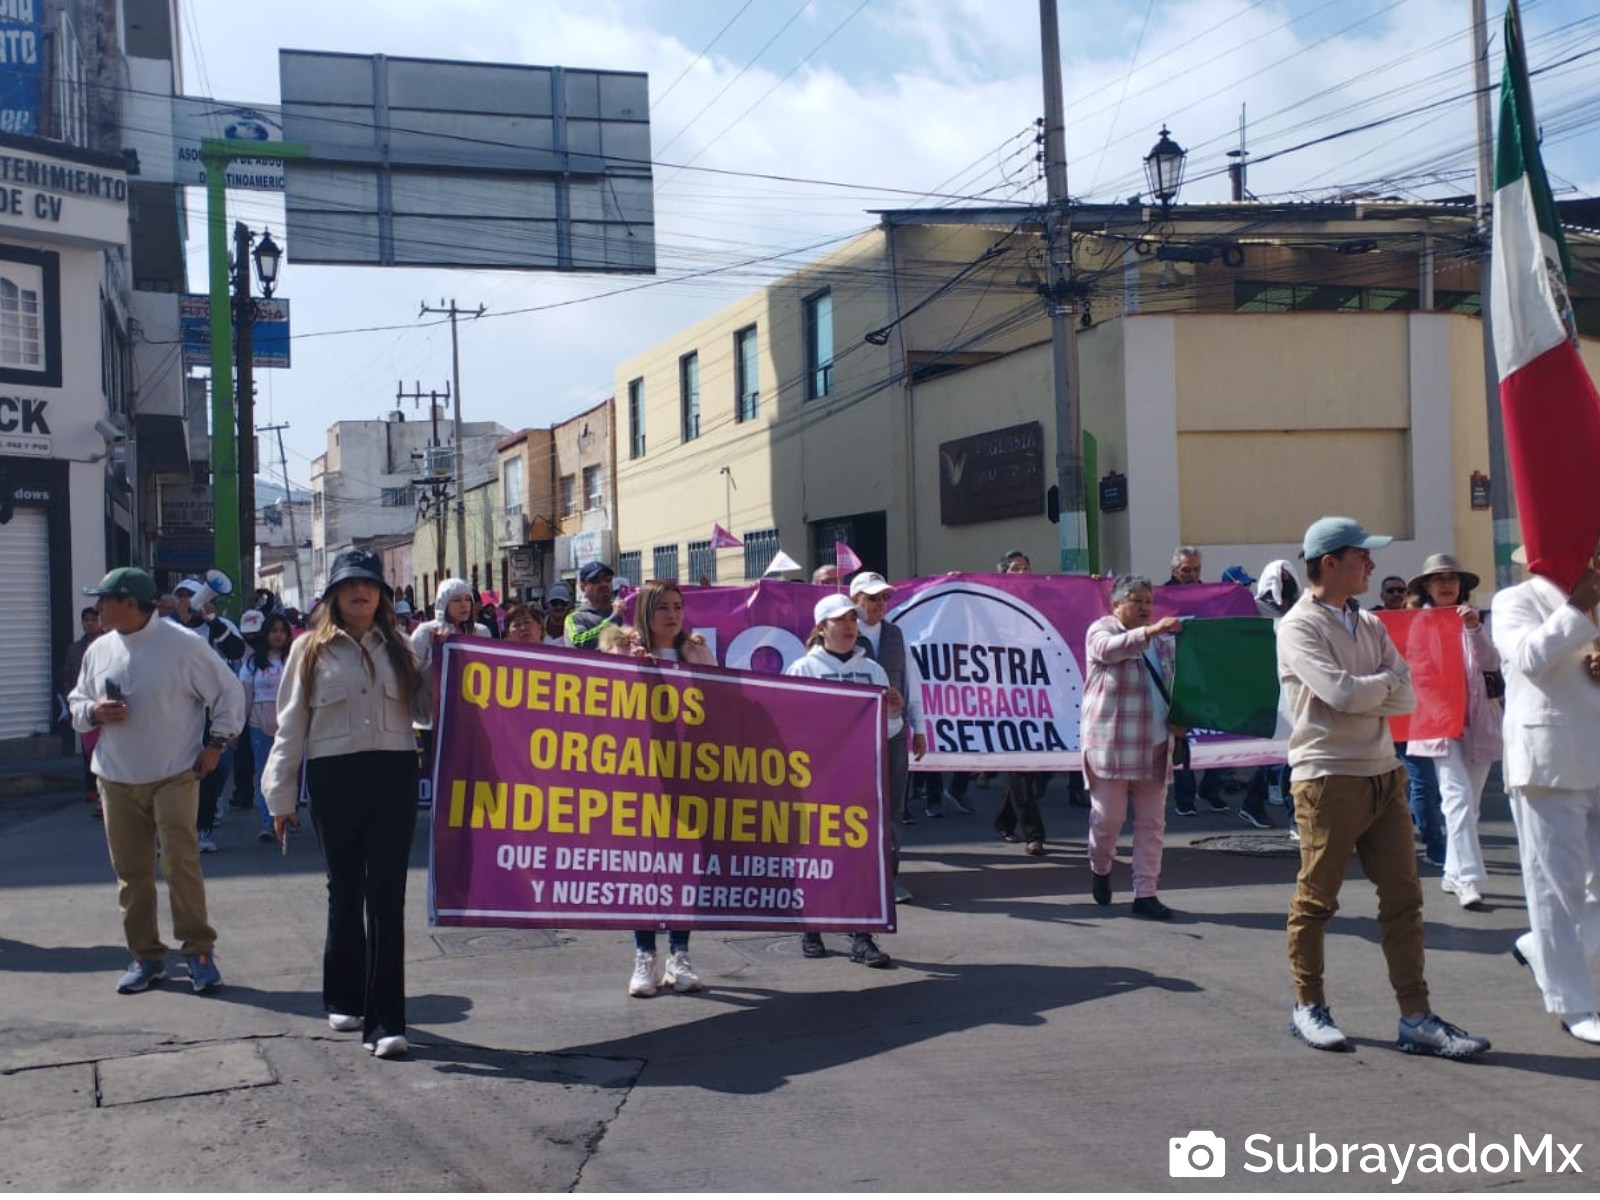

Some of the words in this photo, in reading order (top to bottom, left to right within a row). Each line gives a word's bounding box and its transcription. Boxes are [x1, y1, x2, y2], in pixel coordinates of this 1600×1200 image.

[0, 155, 126, 202] TENIMIENTO
[35, 192, 62, 222] CV
[0, 397, 51, 434] CK
[461, 662, 706, 726] QUEREMOS
[921, 683, 1054, 719] MOCRACIA
[529, 727, 812, 788] ORGANISMOS
[448, 779, 869, 849] INDEPENDIENTES
[496, 844, 547, 871] QUE
[555, 847, 684, 875] DEFIENDAN
[692, 852, 721, 876] LA
[730, 854, 834, 880] LIBERTAD
[530, 880, 545, 903] Y
[552, 880, 674, 907] NUESTROS
[681, 885, 805, 910] DERECHOS
